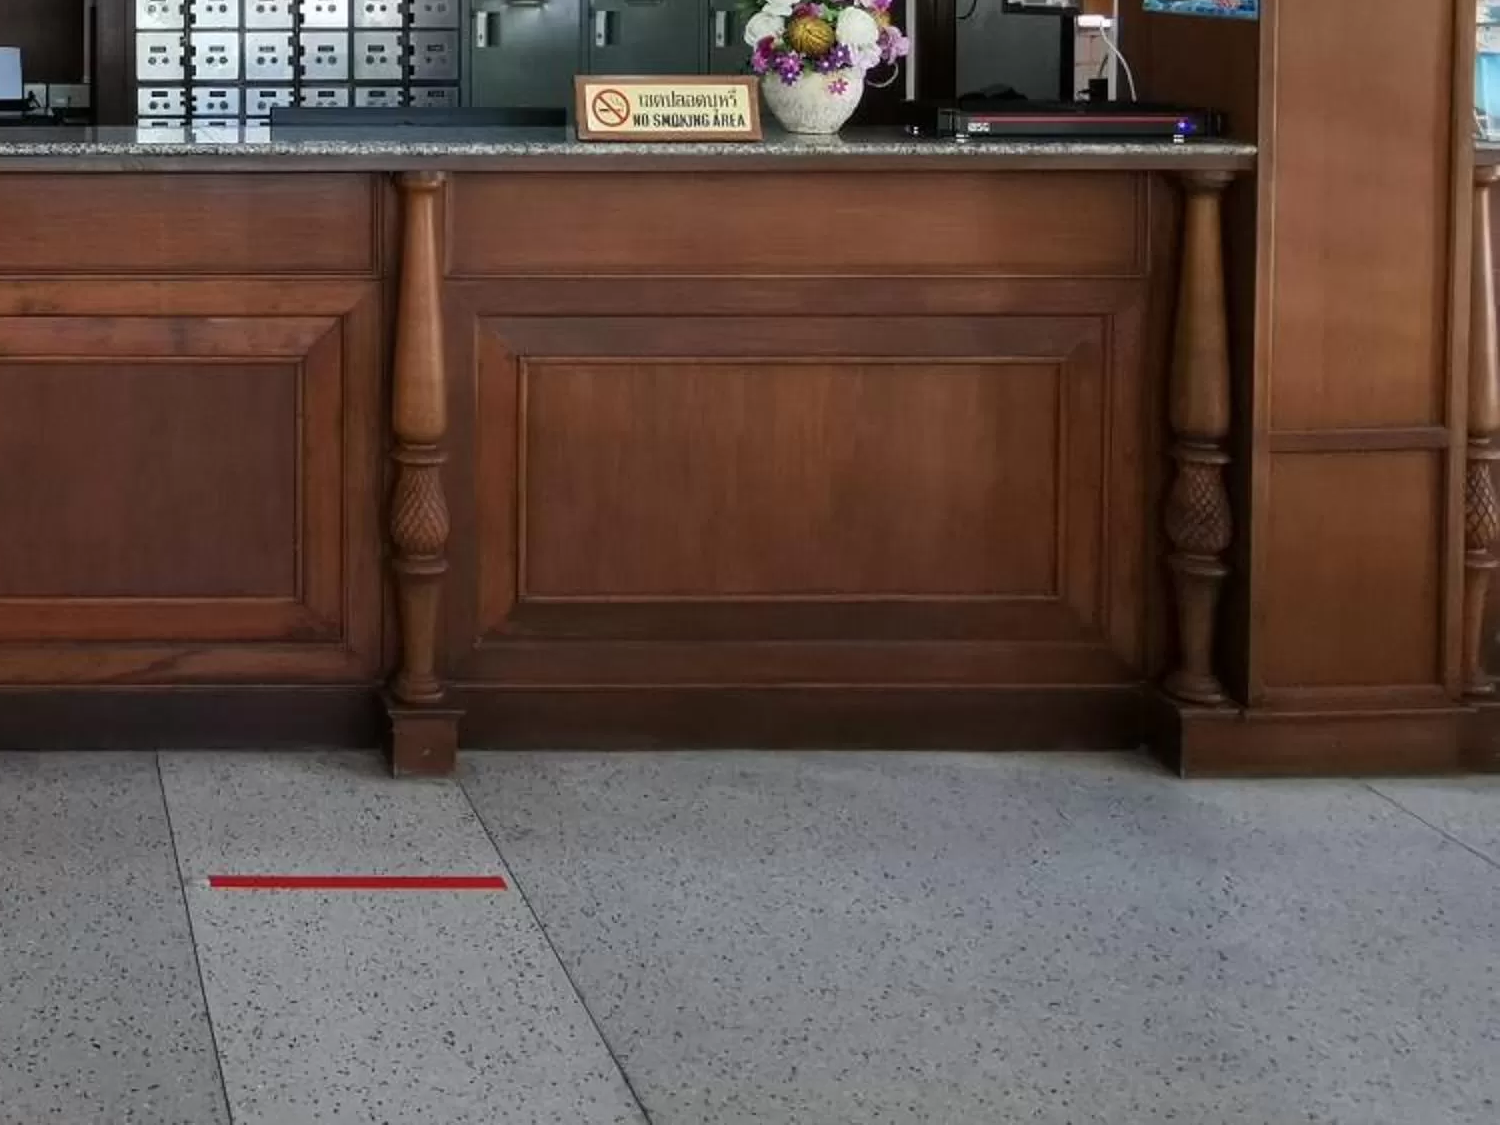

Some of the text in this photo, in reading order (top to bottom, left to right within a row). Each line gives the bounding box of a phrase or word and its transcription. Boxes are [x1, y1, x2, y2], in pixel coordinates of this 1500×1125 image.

[633, 113, 746, 127] NO SMOKING AREA
